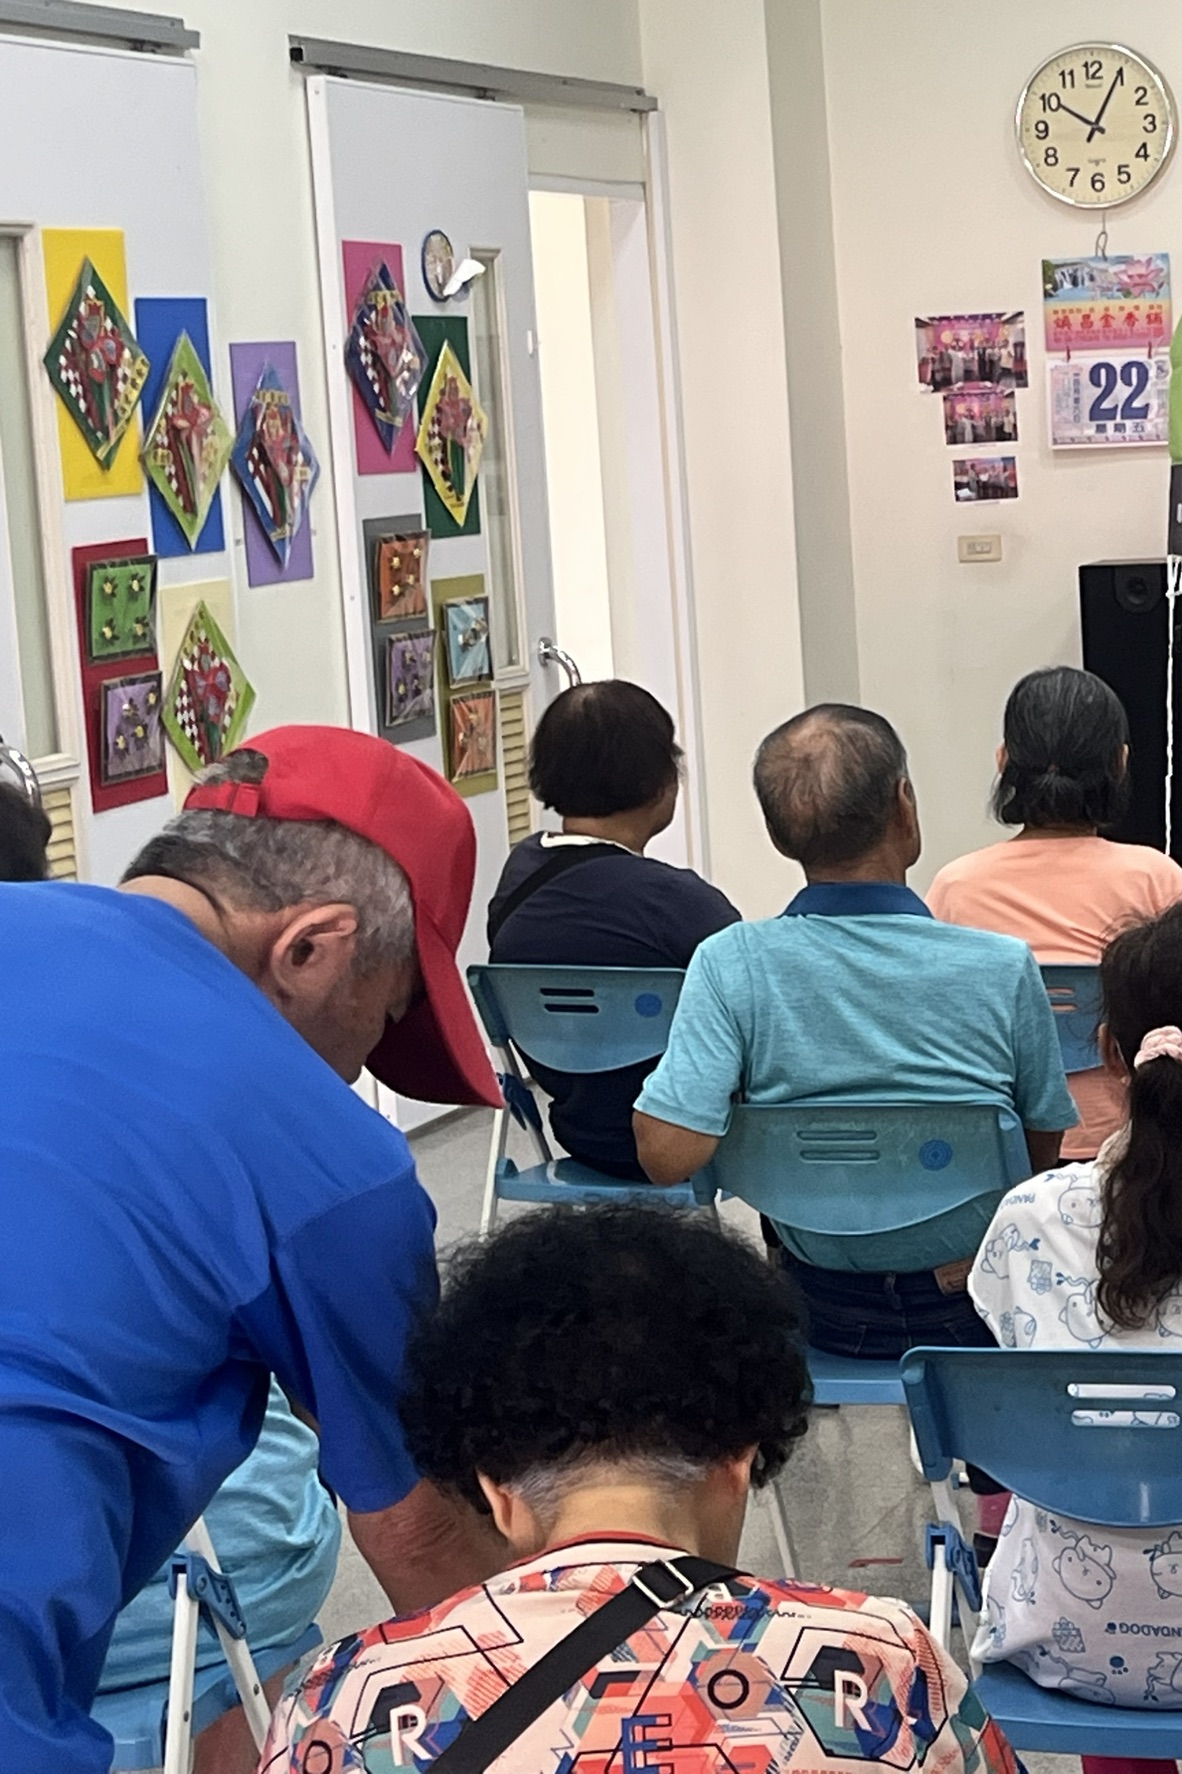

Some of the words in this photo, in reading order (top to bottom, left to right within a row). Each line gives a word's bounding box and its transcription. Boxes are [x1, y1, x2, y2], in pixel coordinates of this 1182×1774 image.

[1059, 69, 1075, 89] 11
[1082, 60, 1103, 80] 12
[1039, 92, 1061, 113] 10
[1134, 86, 1149, 106] 2
[1035, 120, 1049, 140] 9
[1142, 113, 1157, 133] 3
[1044, 147, 1058, 167] 8
[1134, 142, 1150, 162] 4
[1066, 167, 1080, 187] 7
[1091, 172, 1105, 192] 6
[1117, 164, 1131, 184] 5
[1089, 361, 1150, 421] 22
